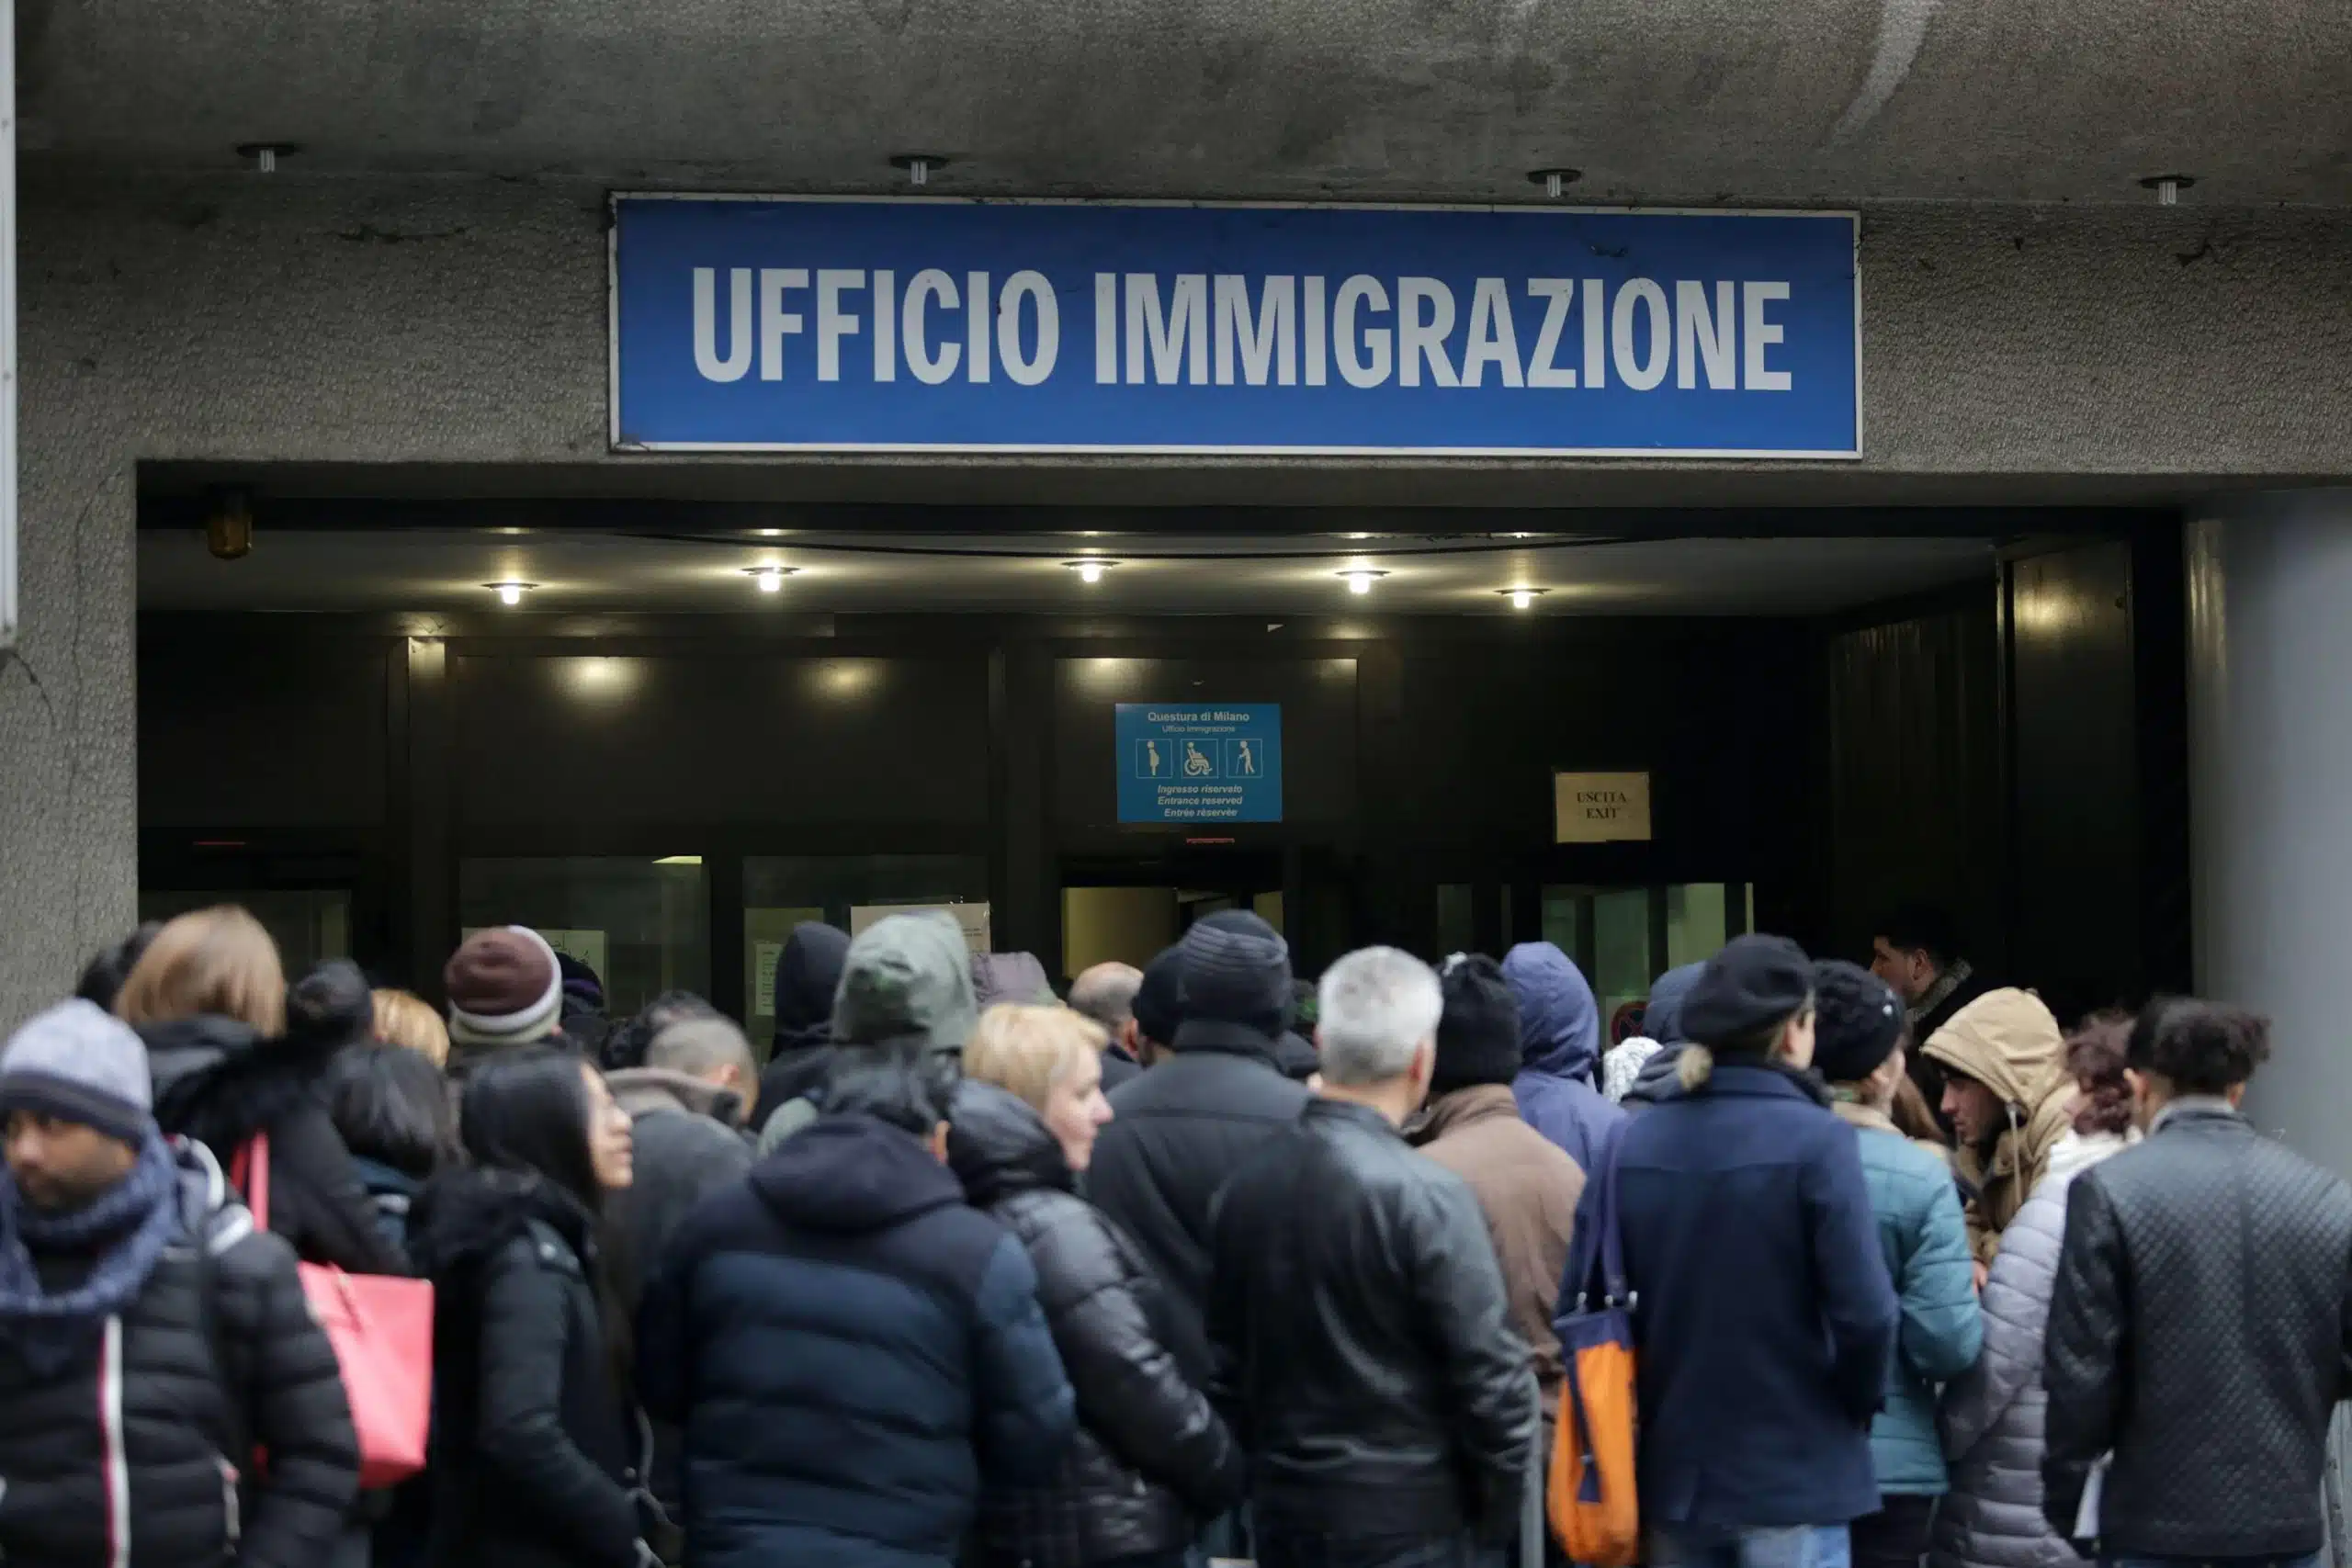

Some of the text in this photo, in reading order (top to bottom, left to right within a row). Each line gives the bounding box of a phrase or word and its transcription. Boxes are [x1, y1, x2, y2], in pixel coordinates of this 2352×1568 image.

[693, 267, 1792, 391] UFFICIO IMMIGRAZIONE
[1148, 711, 1250, 722] Questura di Milano
[1162, 725, 1185, 733] Ufficio
[1158, 784, 1242, 795] Ingresso riservato
[1158, 795, 1242, 805] Entrance reserved
[1577, 792, 1627, 804] USCITA
[1586, 807, 1620, 819] EXIT
